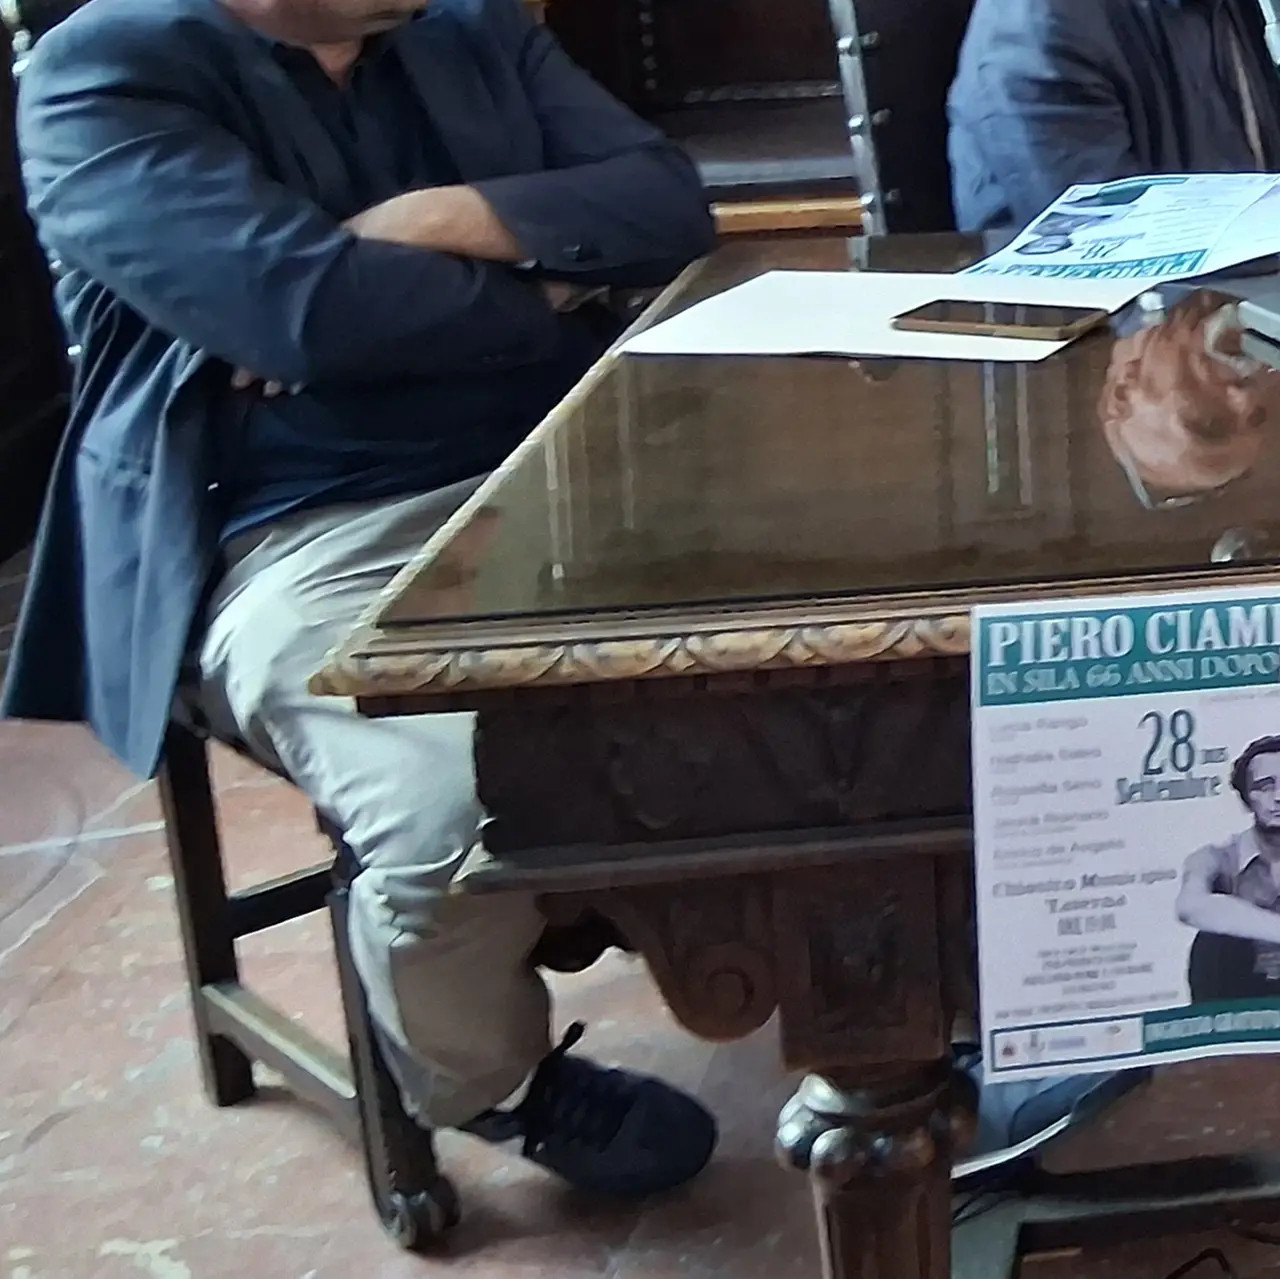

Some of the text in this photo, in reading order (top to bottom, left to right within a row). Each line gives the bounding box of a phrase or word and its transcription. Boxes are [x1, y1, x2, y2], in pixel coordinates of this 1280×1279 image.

[988, 614, 1134, 667] PIERO
[987, 651, 1280, 696] IN SILA 66 ANNI DOPO
[1136, 709, 1195, 776] 28
